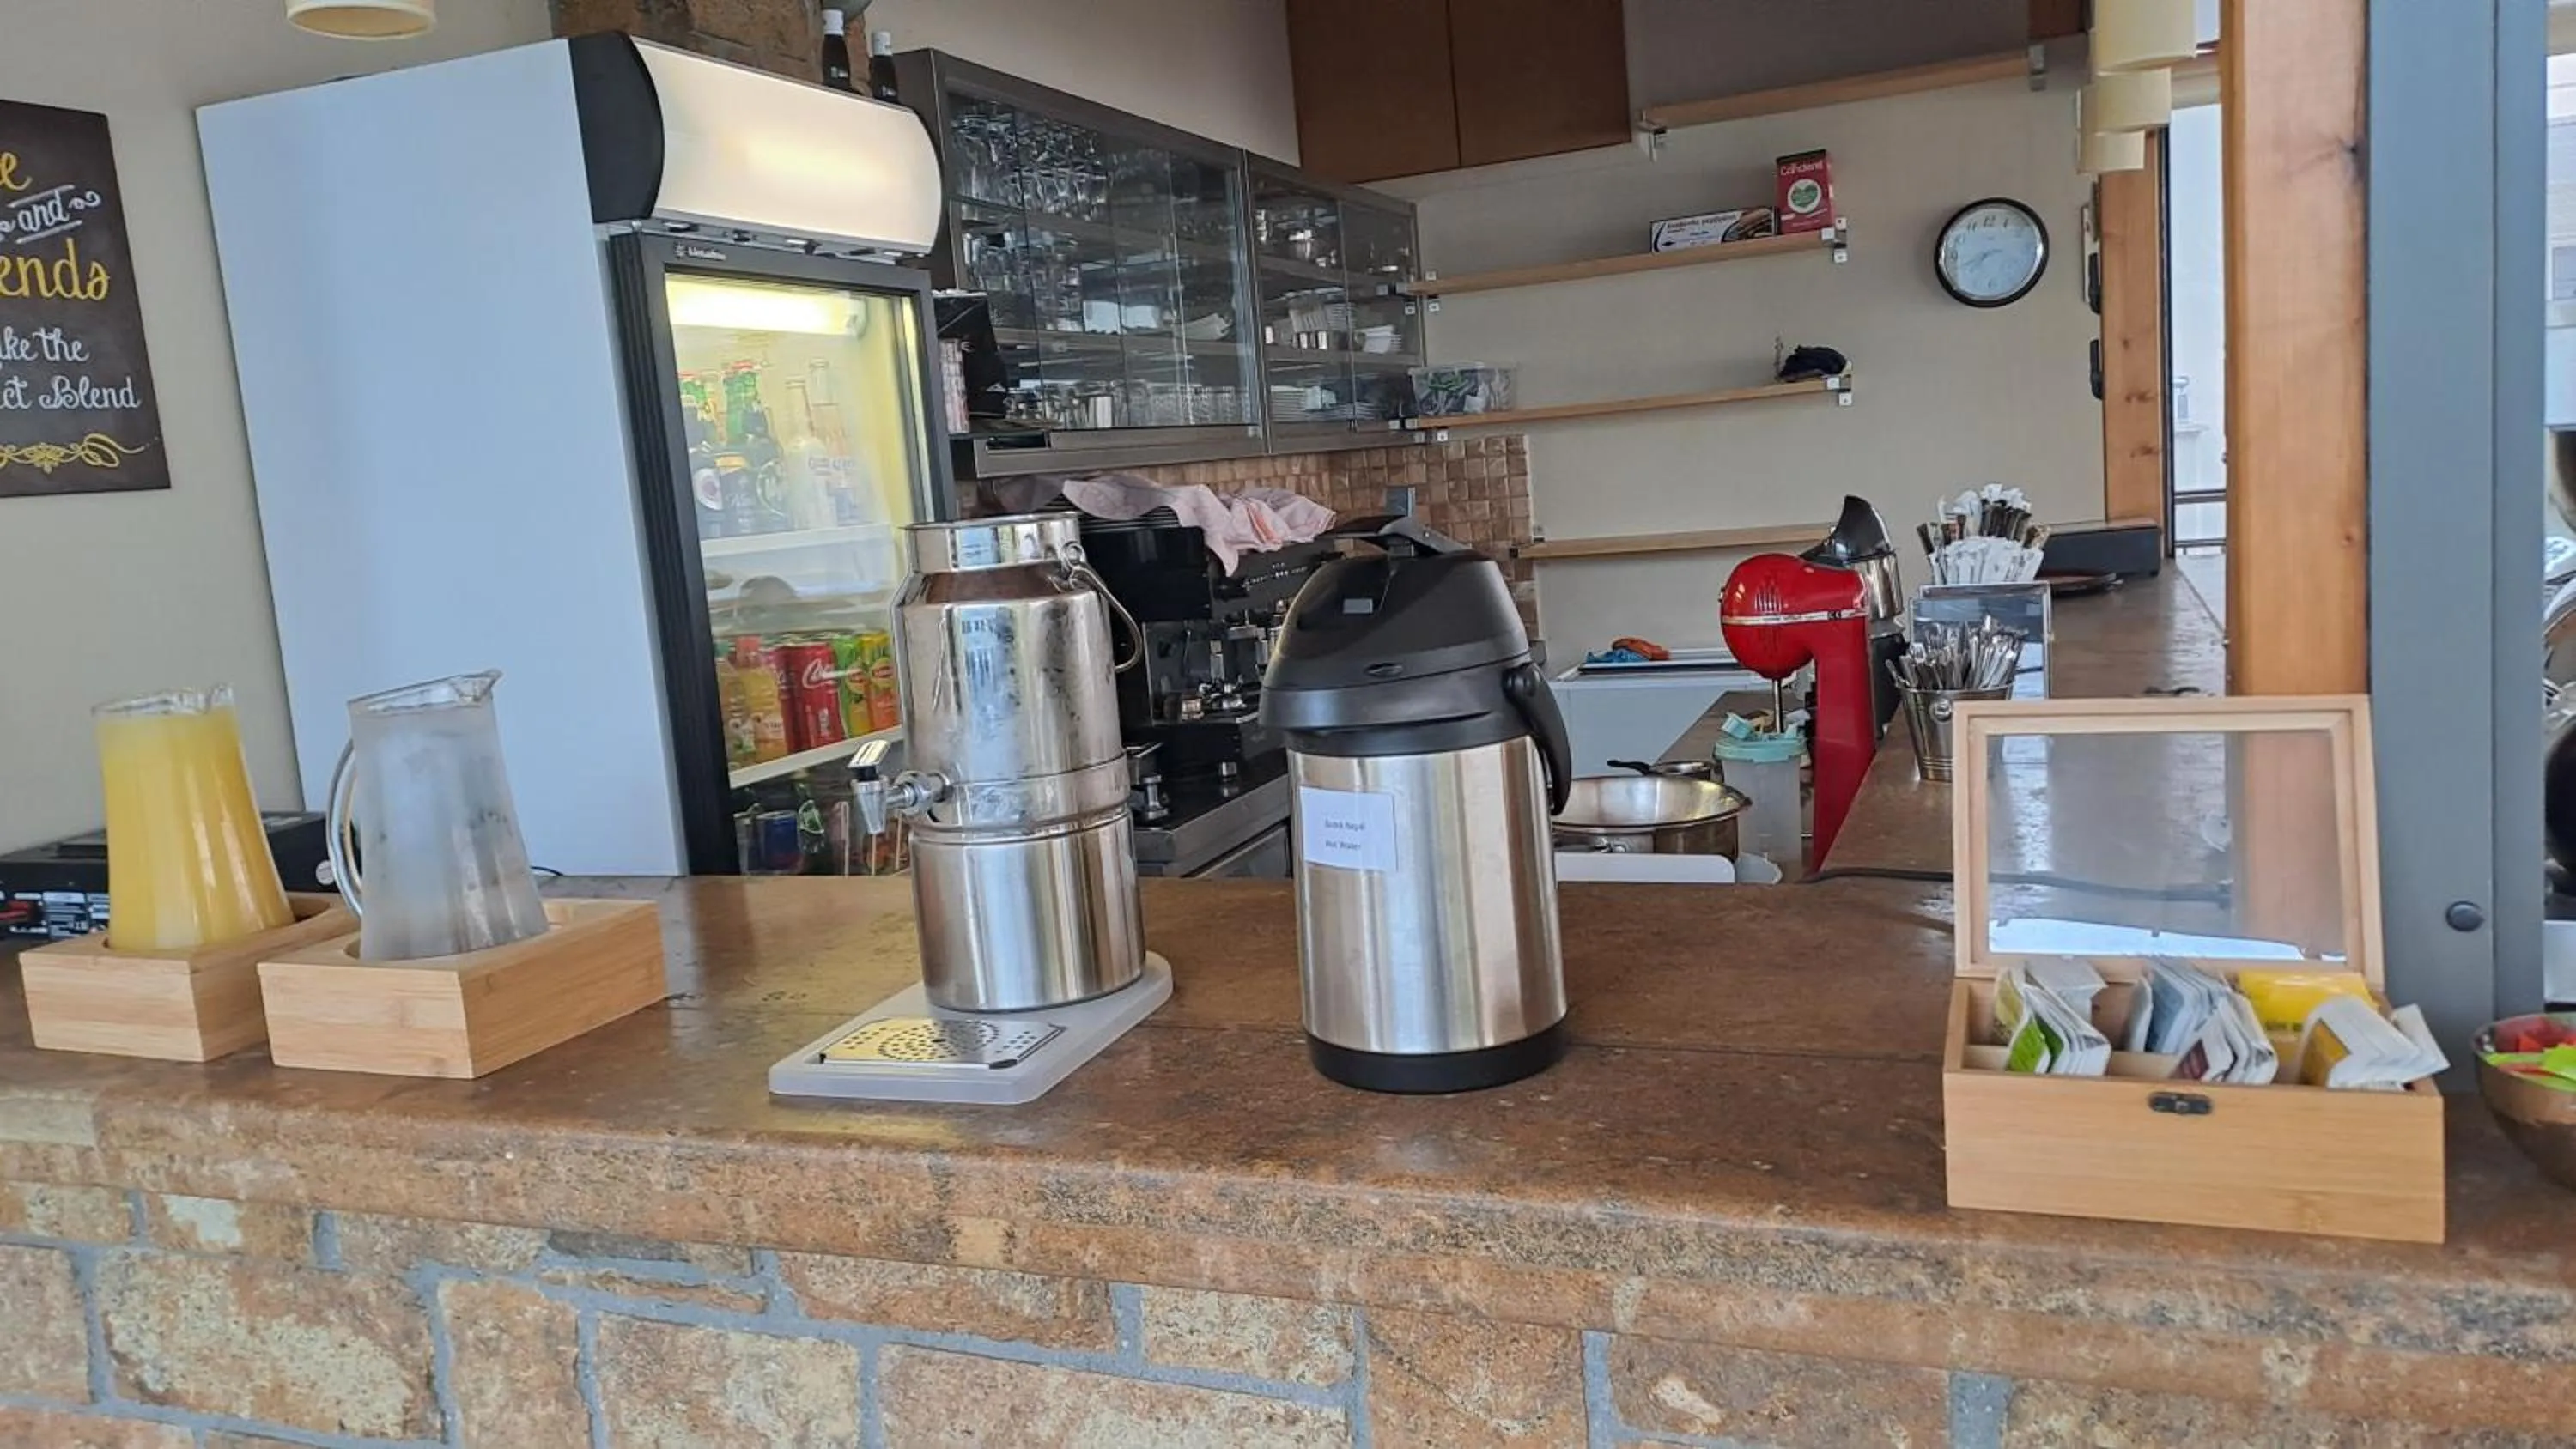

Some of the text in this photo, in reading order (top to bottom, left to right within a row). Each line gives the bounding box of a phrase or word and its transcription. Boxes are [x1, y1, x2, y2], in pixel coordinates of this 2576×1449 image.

[17, 188, 70, 233] and
[0, 237, 111, 300] ends
[32, 327, 89, 361] the
[39, 375, 143, 409] Blend
